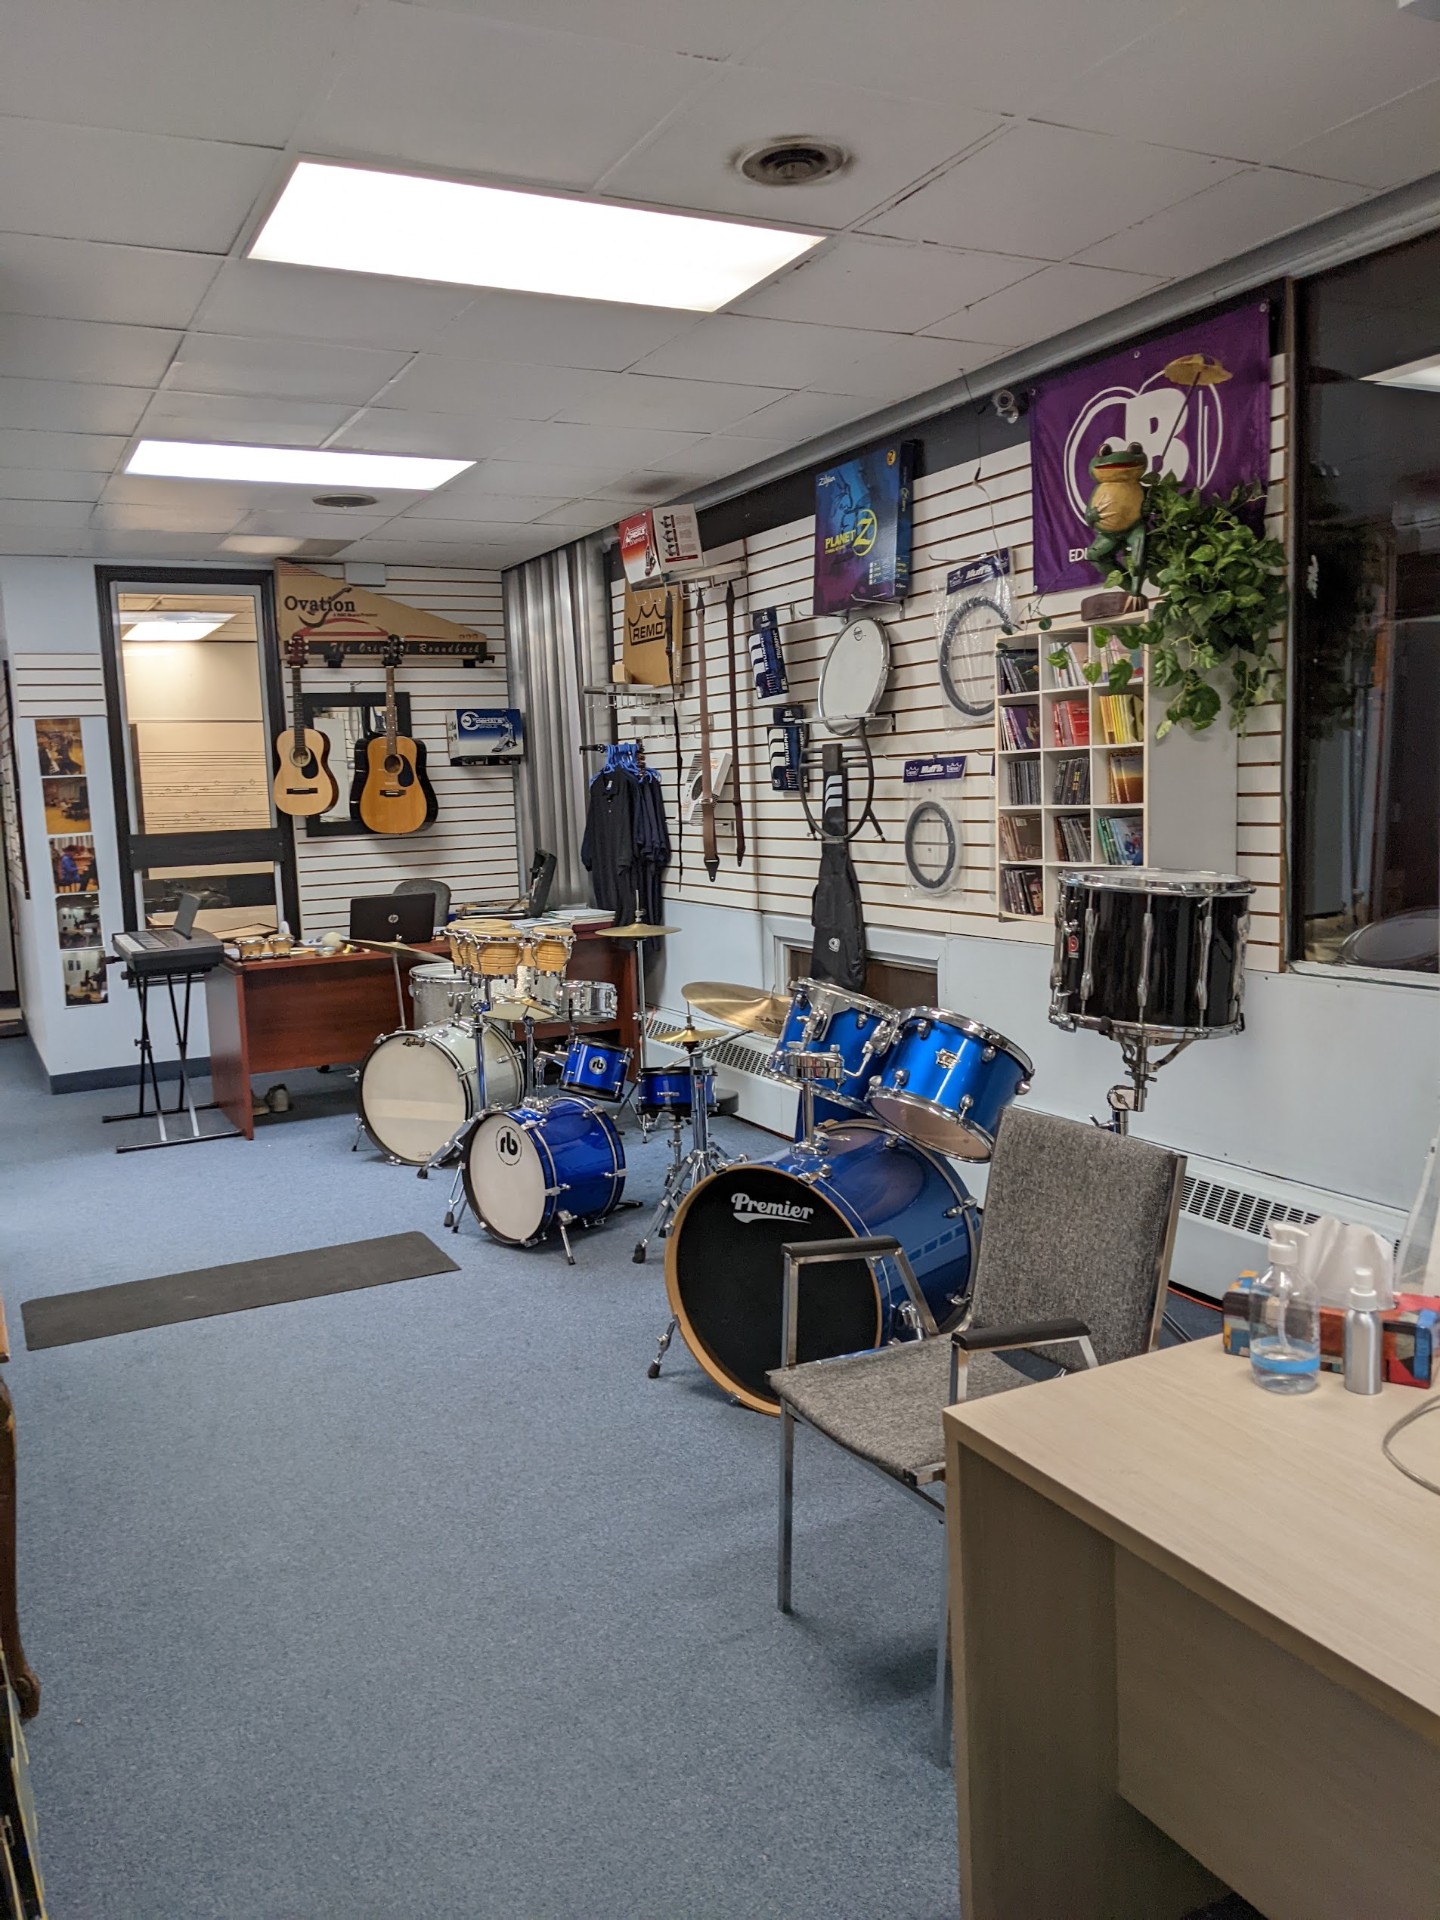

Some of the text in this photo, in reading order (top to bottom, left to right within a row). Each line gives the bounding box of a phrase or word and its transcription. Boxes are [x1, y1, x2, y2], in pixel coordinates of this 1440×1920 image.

[825, 530, 856, 549] PLANET
[284, 595, 356, 612] Ovation
[633, 621, 664, 641] REMO
[592, 1059, 604, 1070] rb
[500, 1131, 518, 1156] rb
[731, 1192, 814, 1219] Premier
